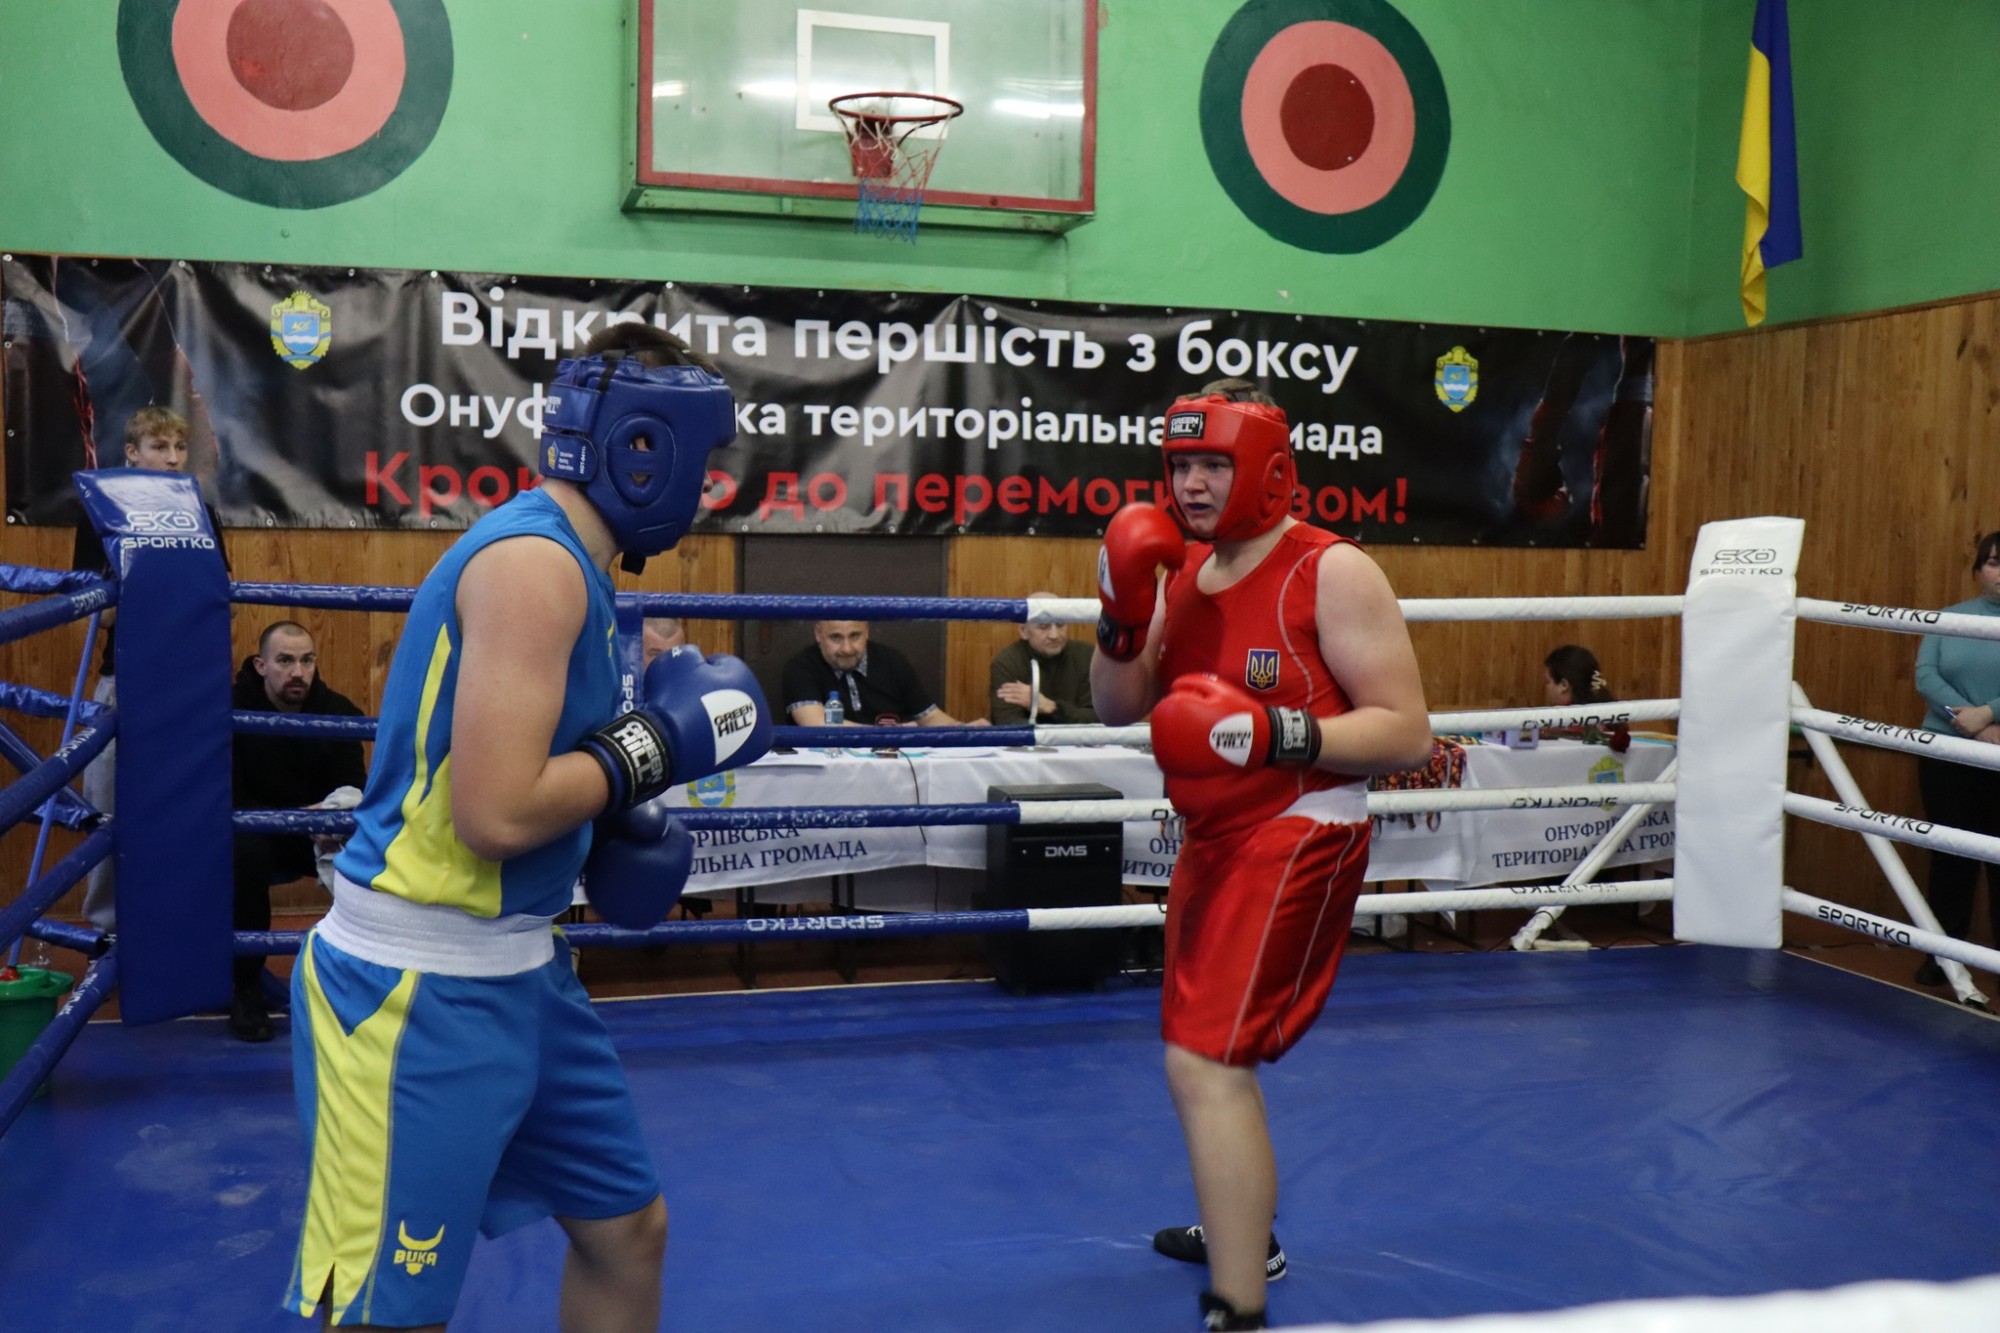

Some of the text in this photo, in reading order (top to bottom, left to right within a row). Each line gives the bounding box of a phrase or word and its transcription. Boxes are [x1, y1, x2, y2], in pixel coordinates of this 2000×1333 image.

[795, 307, 1106, 374] першість
[1126, 332, 1156, 373] з
[1177, 319, 1359, 395] боксу
[803, 396, 1165, 449] територіальна
[759, 471, 848, 522] до
[121, 536, 215, 549] SPORTKO
[1699, 567, 1783, 576] SPORTKO
[1840, 602, 1942, 625] SPORTKO
[714, 703, 754, 727] GREEN
[717, 716, 753, 738] HILL
[1523, 712, 1631, 729] SPORTKO
[1837, 715, 1937, 745] SPORTKO
[613, 726, 652, 784] HILL
[626, 721, 664, 785] GREEN
[760, 839, 869, 868] ГРОМАДА
[1044, 844, 1088, 858] DMS
[746, 914, 885, 932] SPORTKO
[1817, 904, 1912, 946] SPORTKO
[393, 1248, 438, 1267] BUKA
